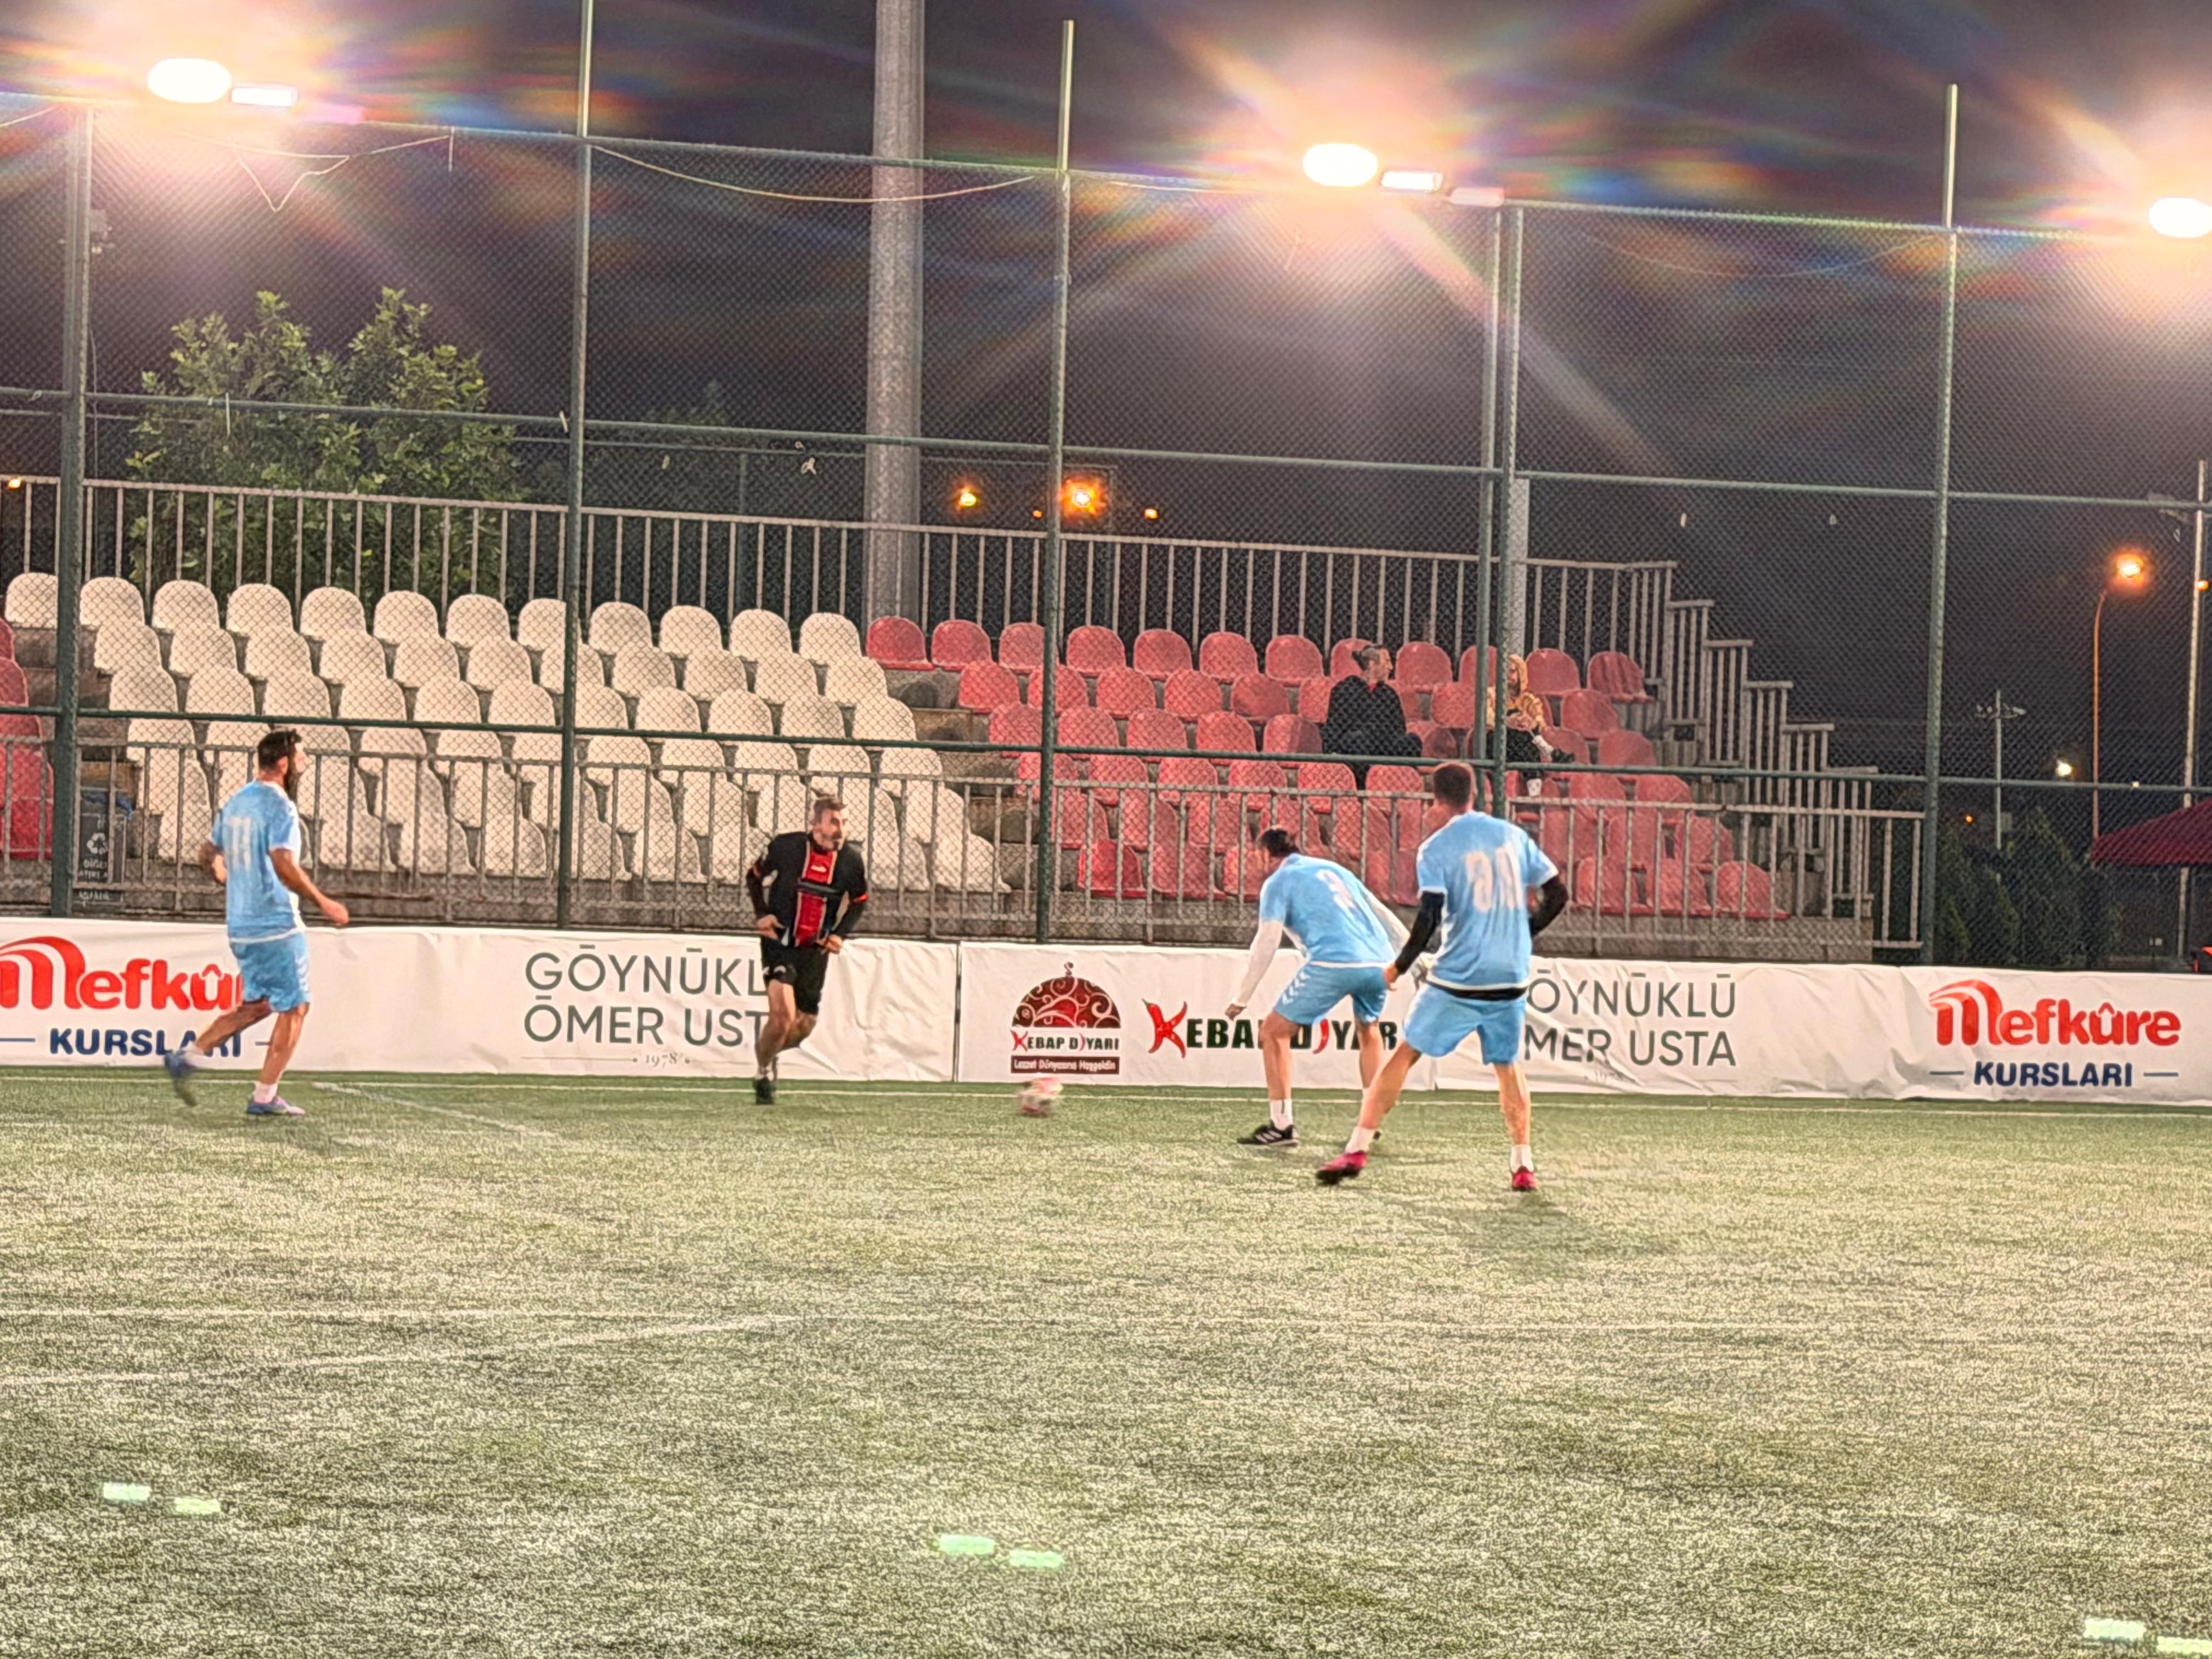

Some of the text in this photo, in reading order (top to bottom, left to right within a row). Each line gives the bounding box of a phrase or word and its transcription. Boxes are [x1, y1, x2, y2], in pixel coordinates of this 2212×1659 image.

[0, 936, 242, 1010] Mefkû
[684, 1008, 770, 1048] UST
[1141, 998, 1263, 1059] KEBA
[1929, 979, 2182, 1046] Mefkûre
[1009, 1029, 1065, 1052] KEBAP
[1524, 1024, 1736, 1066] MER USTA
[1974, 1061, 2133, 1087] KURSLARI
